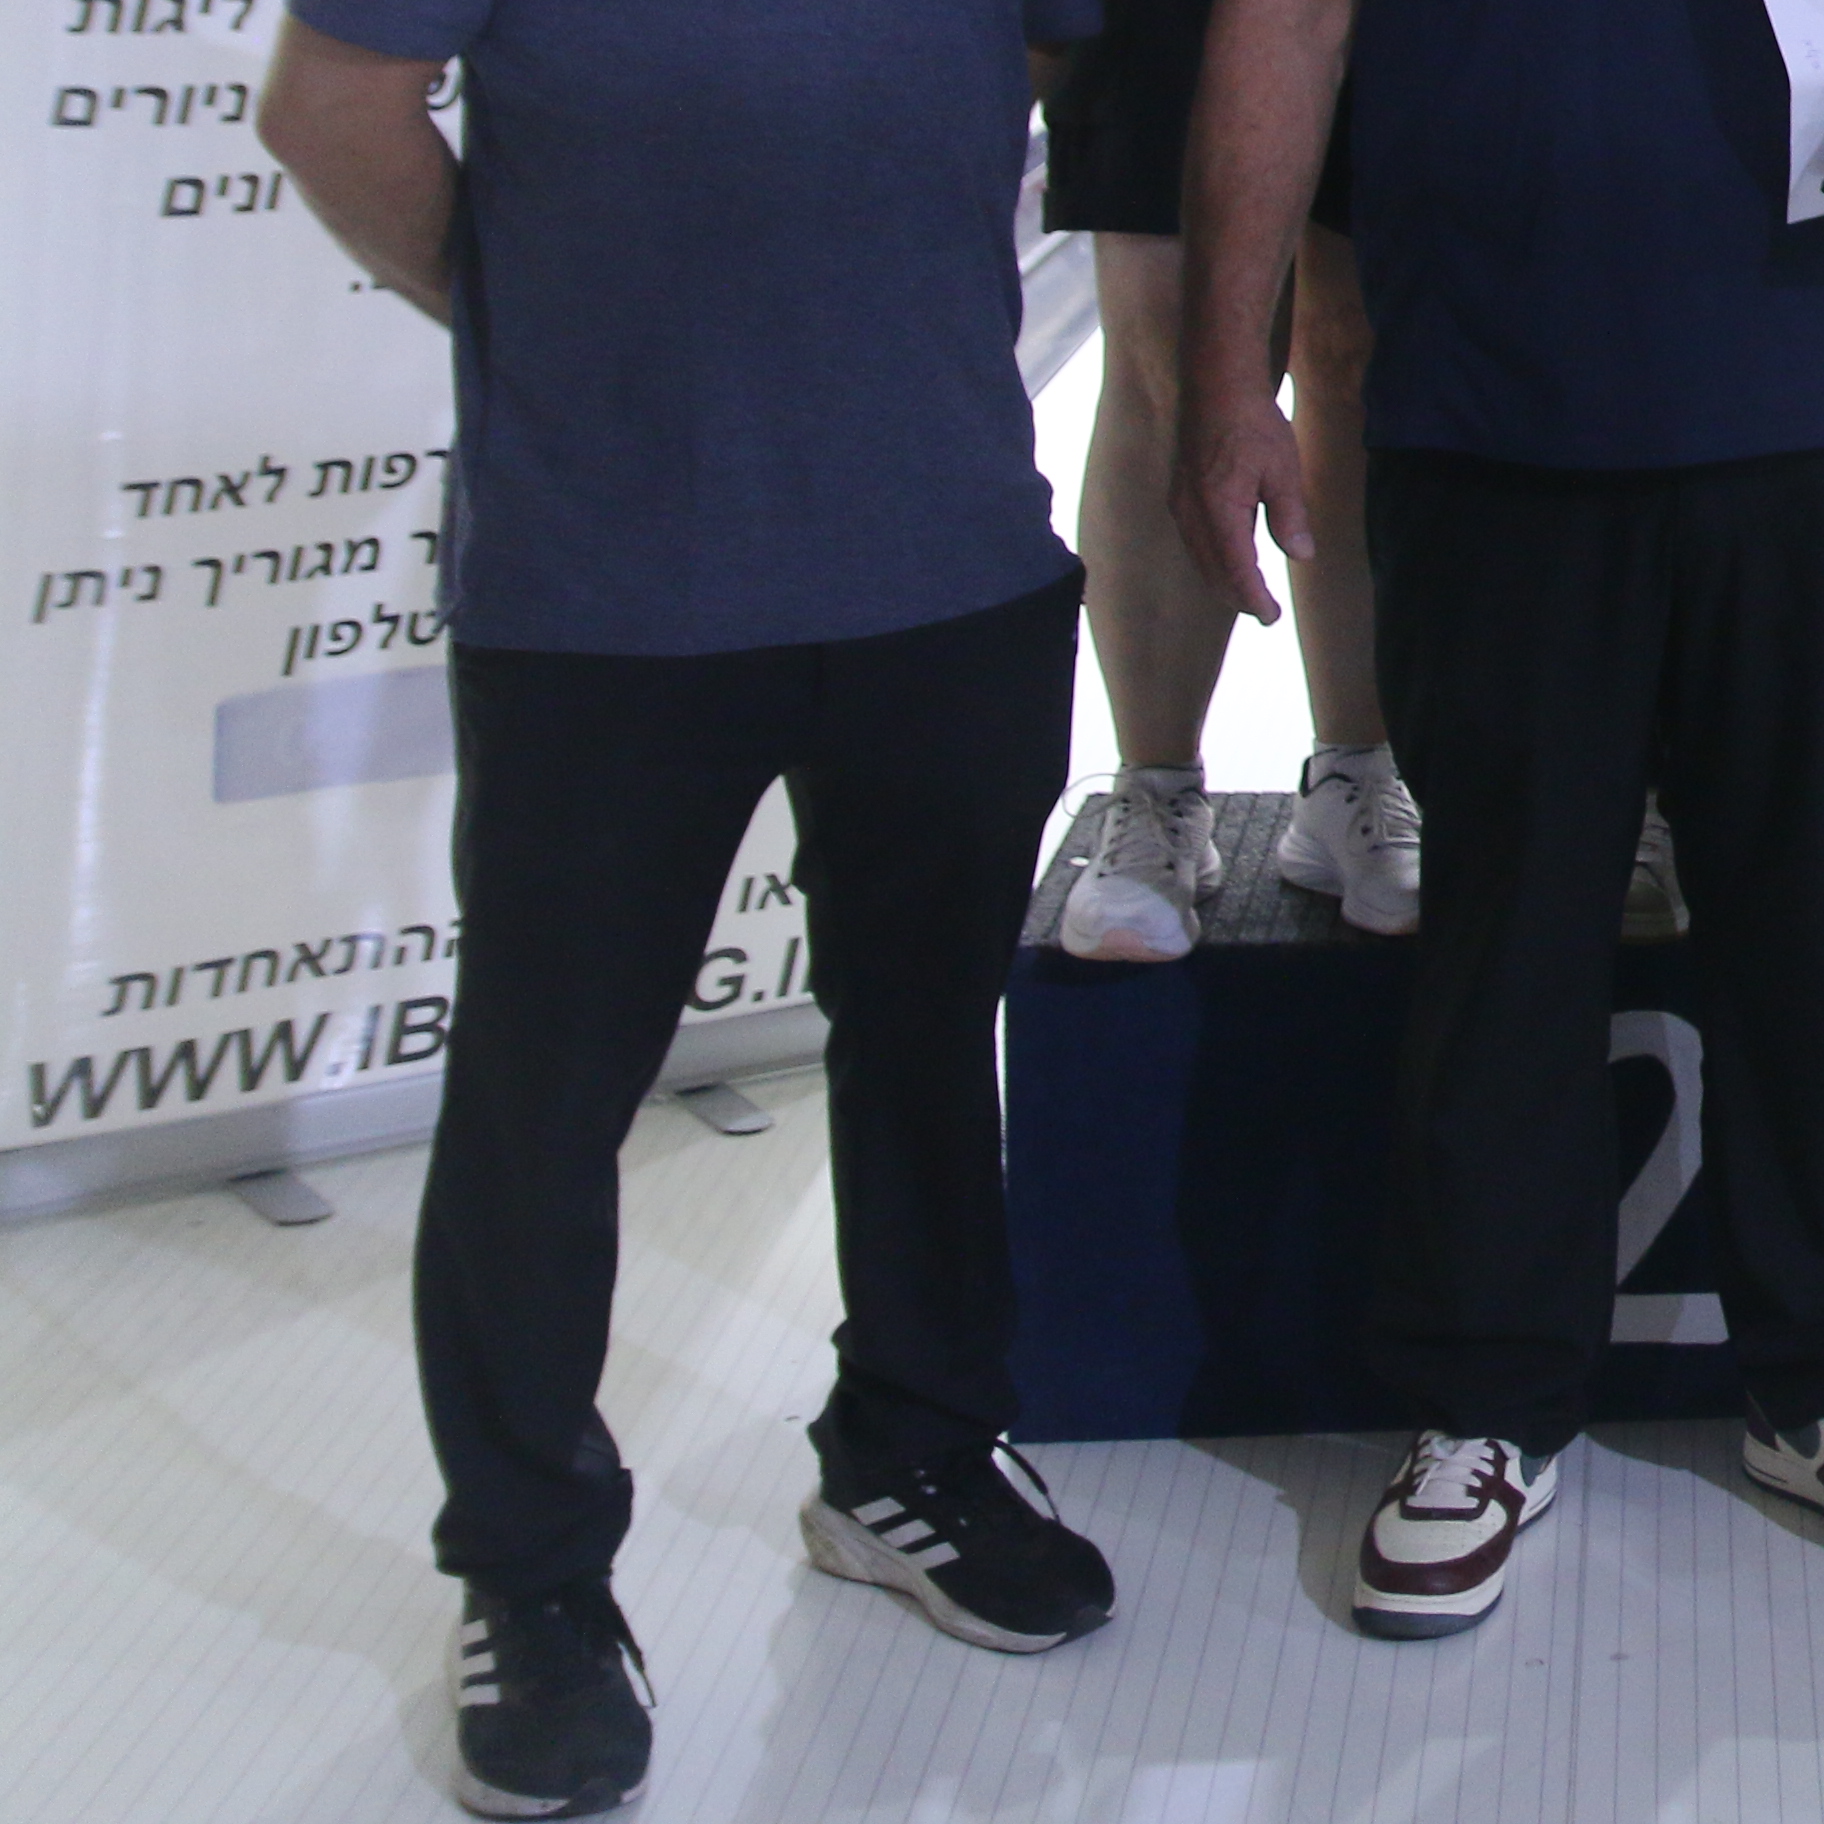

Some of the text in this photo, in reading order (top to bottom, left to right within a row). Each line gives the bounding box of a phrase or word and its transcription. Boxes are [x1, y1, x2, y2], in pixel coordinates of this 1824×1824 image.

[120, 453, 289, 519] לאחד
[30, 563, 163, 624] ניתן
[190, 535, 381, 607] מגוריך
[281, 602, 438, 677] טלפון
[1607, 1010, 1729, 1345] 2
